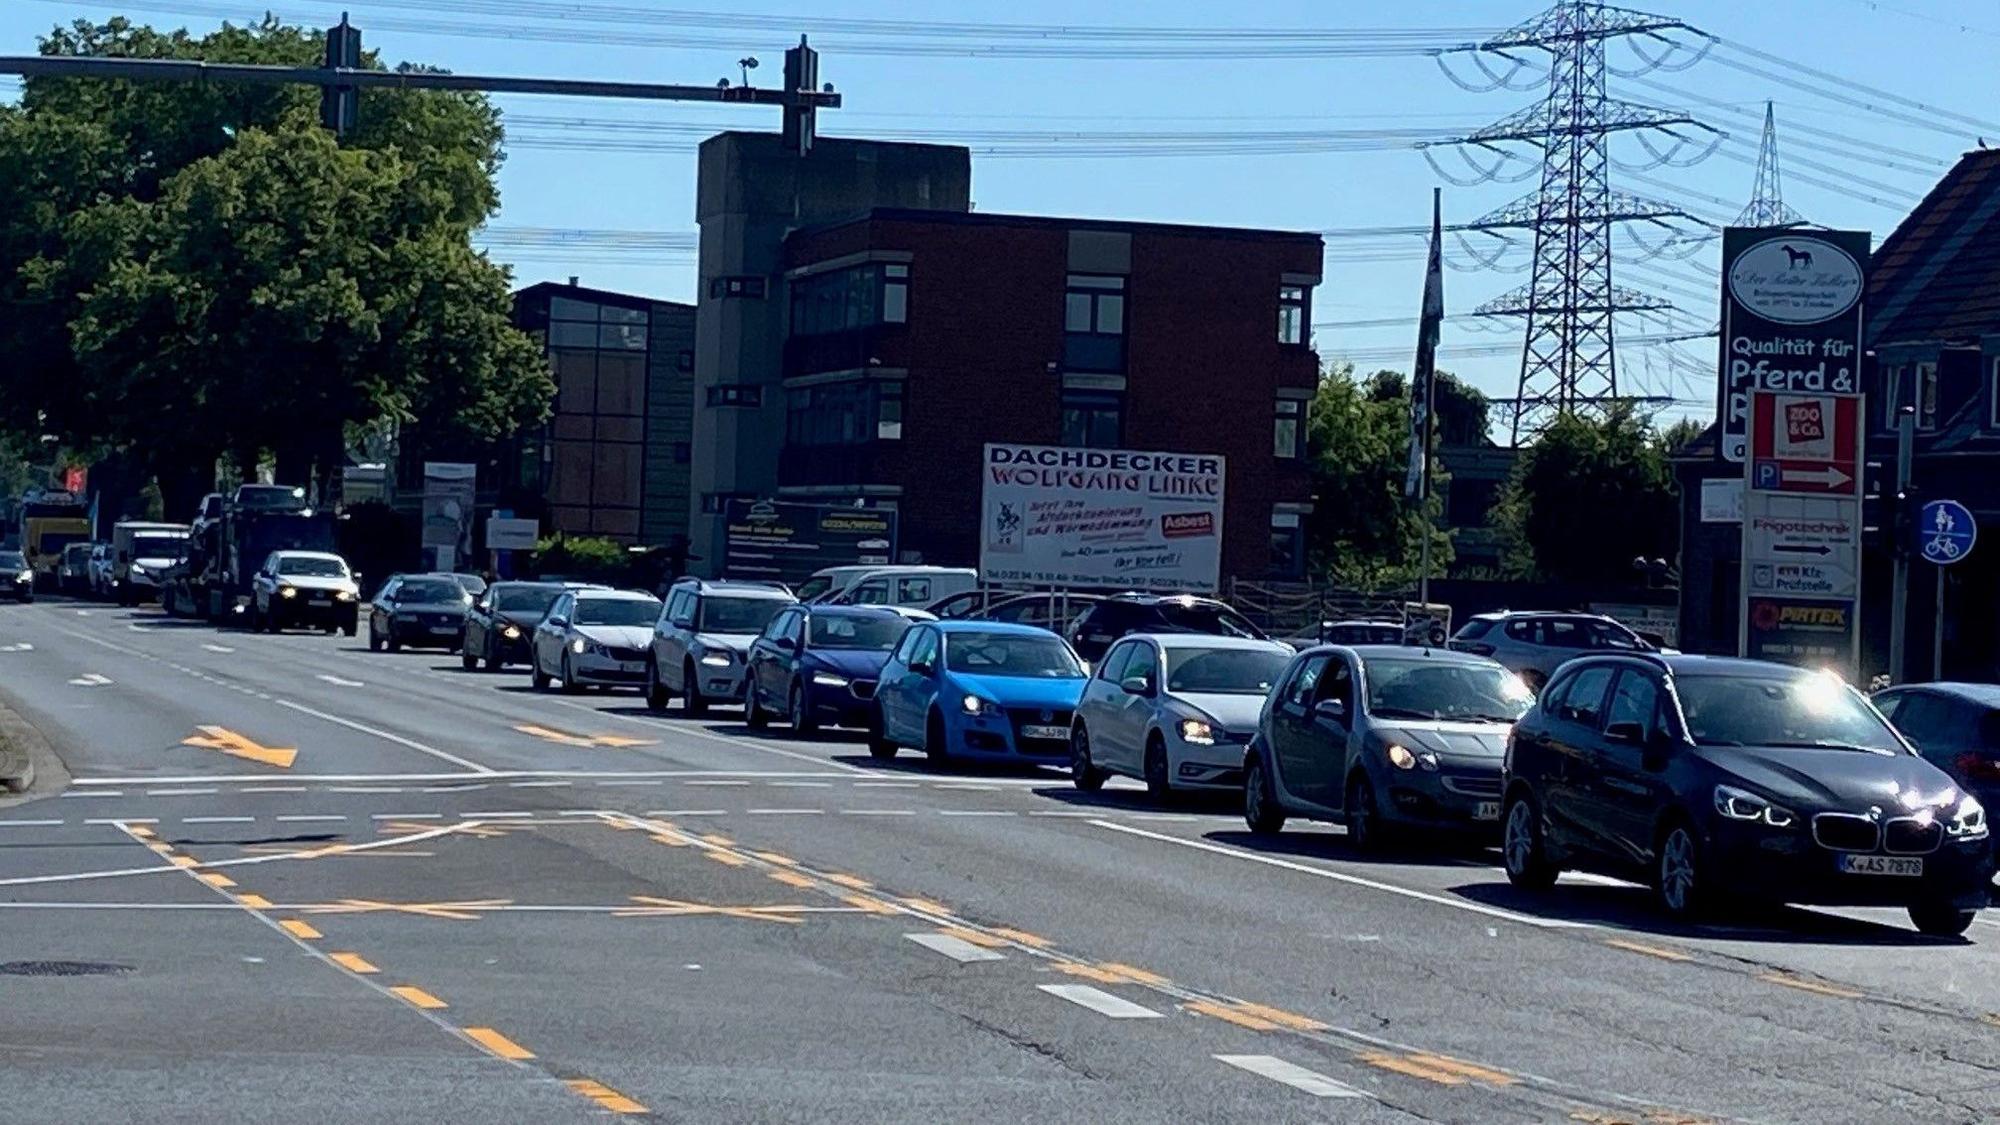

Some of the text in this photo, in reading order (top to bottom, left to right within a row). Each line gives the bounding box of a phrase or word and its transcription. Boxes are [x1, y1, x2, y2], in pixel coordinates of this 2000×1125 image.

[1732, 336, 1853, 357] Qualität für
[1731, 359, 1853, 392] Pferd &
[1789, 407, 1820, 422] ZOO
[991, 447, 1218, 475] DACHDECKER
[1761, 464, 1774, 484] P
[1165, 514, 1210, 529] Asbest
[1780, 606, 1846, 625] PIRTEK
